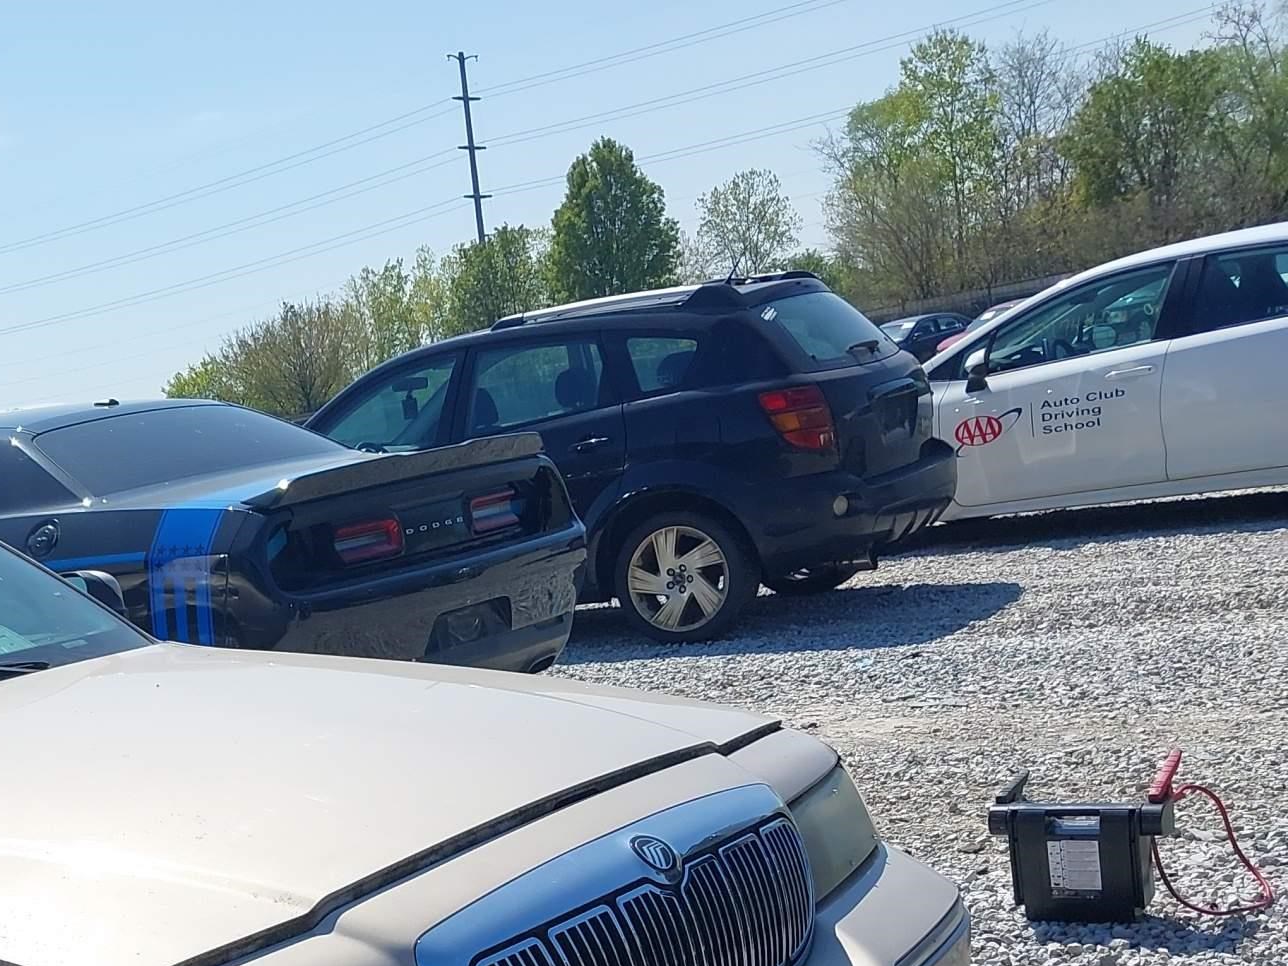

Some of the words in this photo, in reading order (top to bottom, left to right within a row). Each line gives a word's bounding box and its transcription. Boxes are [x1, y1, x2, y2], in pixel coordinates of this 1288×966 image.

[1040, 397, 1080, 410] Auto
[1085, 388, 1126, 402] Club
[1041, 406, 1102, 423] Driving
[958, 416, 1001, 446] AAA
[1042, 418, 1101, 435] School
[405, 515, 464, 536] DODGE
